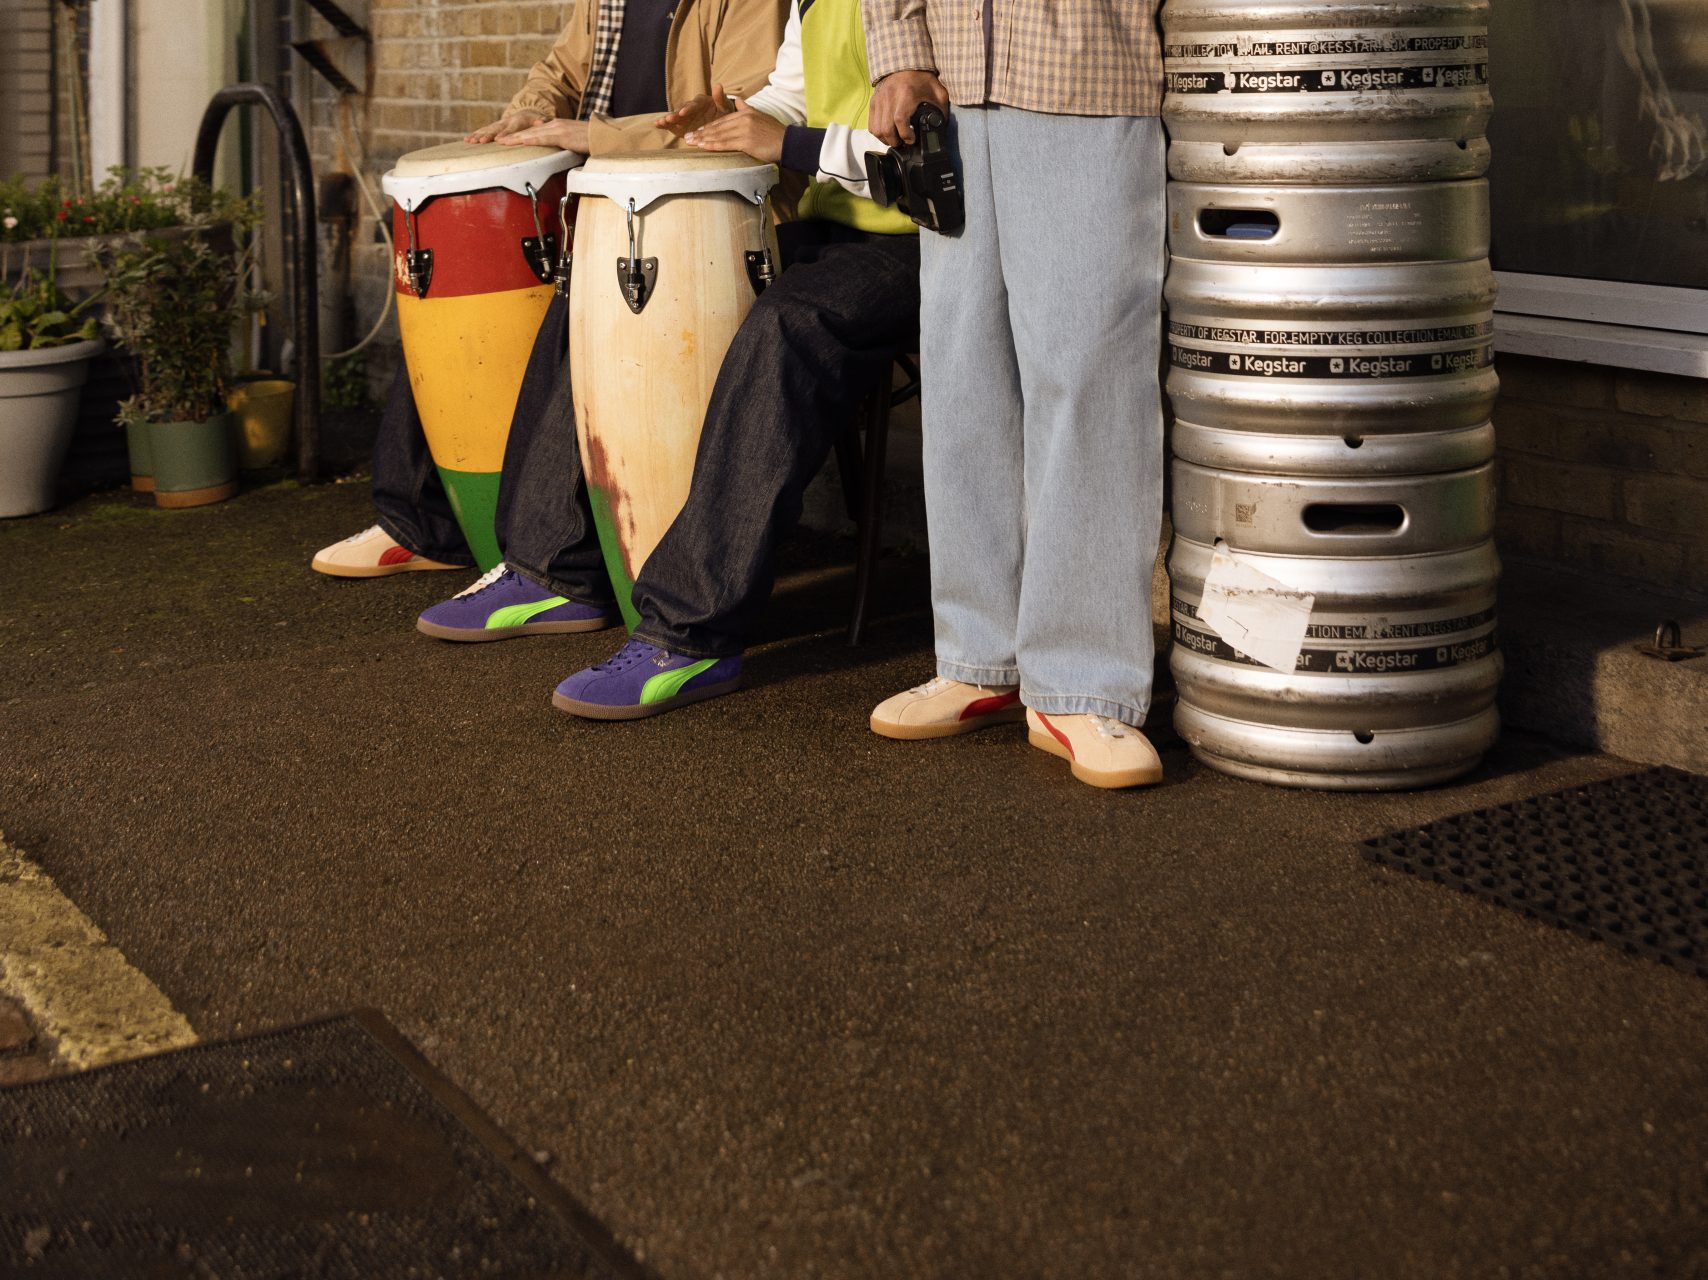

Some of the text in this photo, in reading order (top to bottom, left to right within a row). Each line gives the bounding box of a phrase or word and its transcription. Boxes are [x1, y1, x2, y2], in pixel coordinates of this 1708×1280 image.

[1173, 73, 1209, 92] Kegstar
[1240, 72, 1301, 91] Kegstar
[1340, 69, 1404, 90] Kegstar
[1438, 66, 1477, 86] Kegsta
[1197, 327, 1209, 339] OF
[1264, 331, 1288, 344] FOR
[1291, 332, 1333, 345] EMPTY
[1338, 332, 1362, 345] KEG
[1366, 330, 1435, 344] COLLECTION
[1437, 327, 1463, 341] EMAIL
[1178, 348, 1213, 369] Kegstar
[1245, 356, 1307, 376] Kegstar
[1349, 357, 1412, 377] Kegstar
[1446, 351, 1480, 371] Kegsta
[1181, 625, 1217, 650] Kegstar
[1345, 624, 1382, 639] EMA
[1355, 651, 1418, 672] Kegstar
